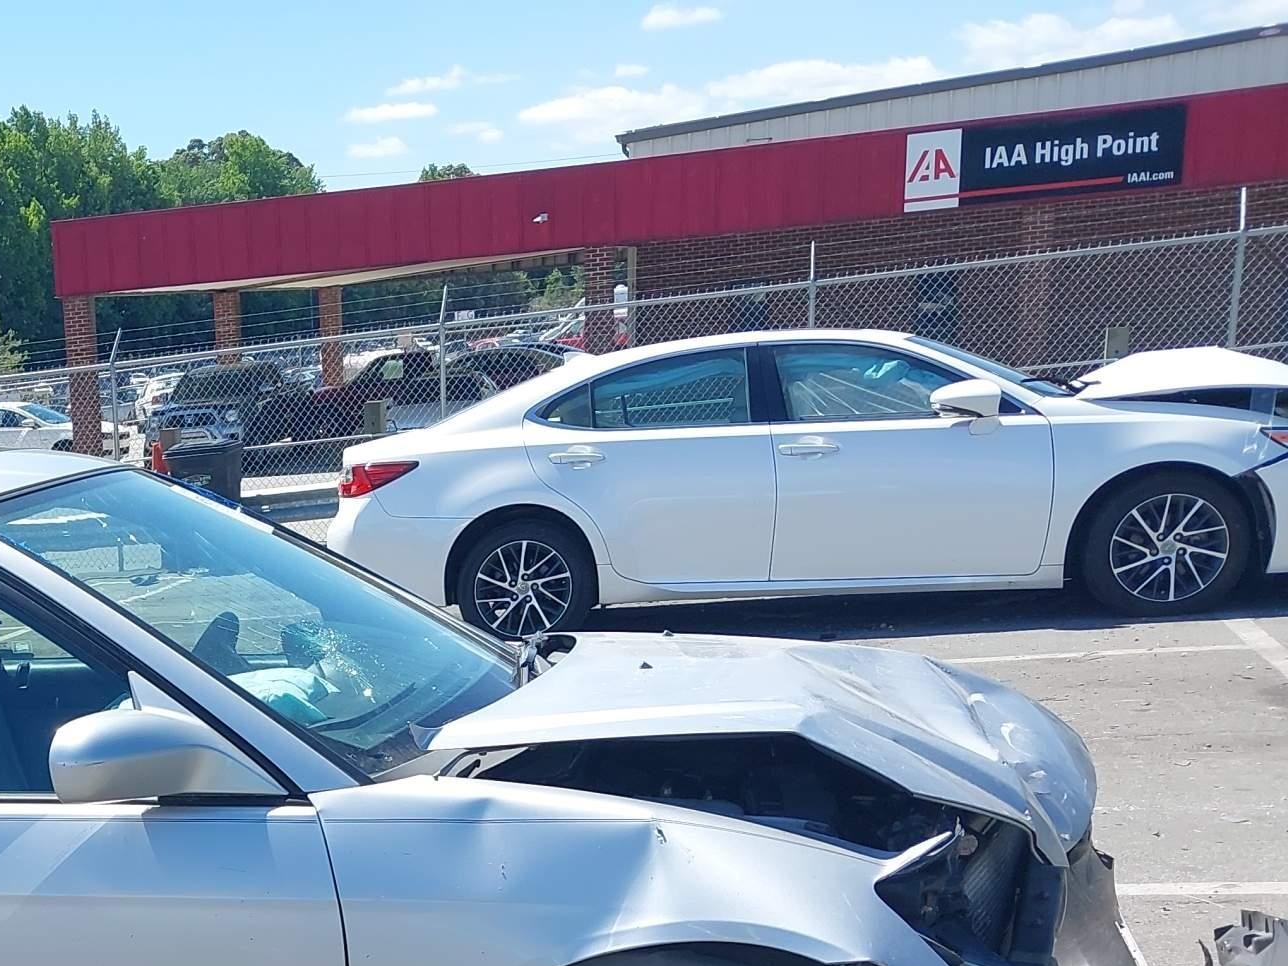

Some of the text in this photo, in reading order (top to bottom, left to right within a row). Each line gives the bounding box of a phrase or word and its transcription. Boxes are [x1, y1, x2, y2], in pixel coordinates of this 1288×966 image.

[984, 131, 1160, 169] IAA High Point
